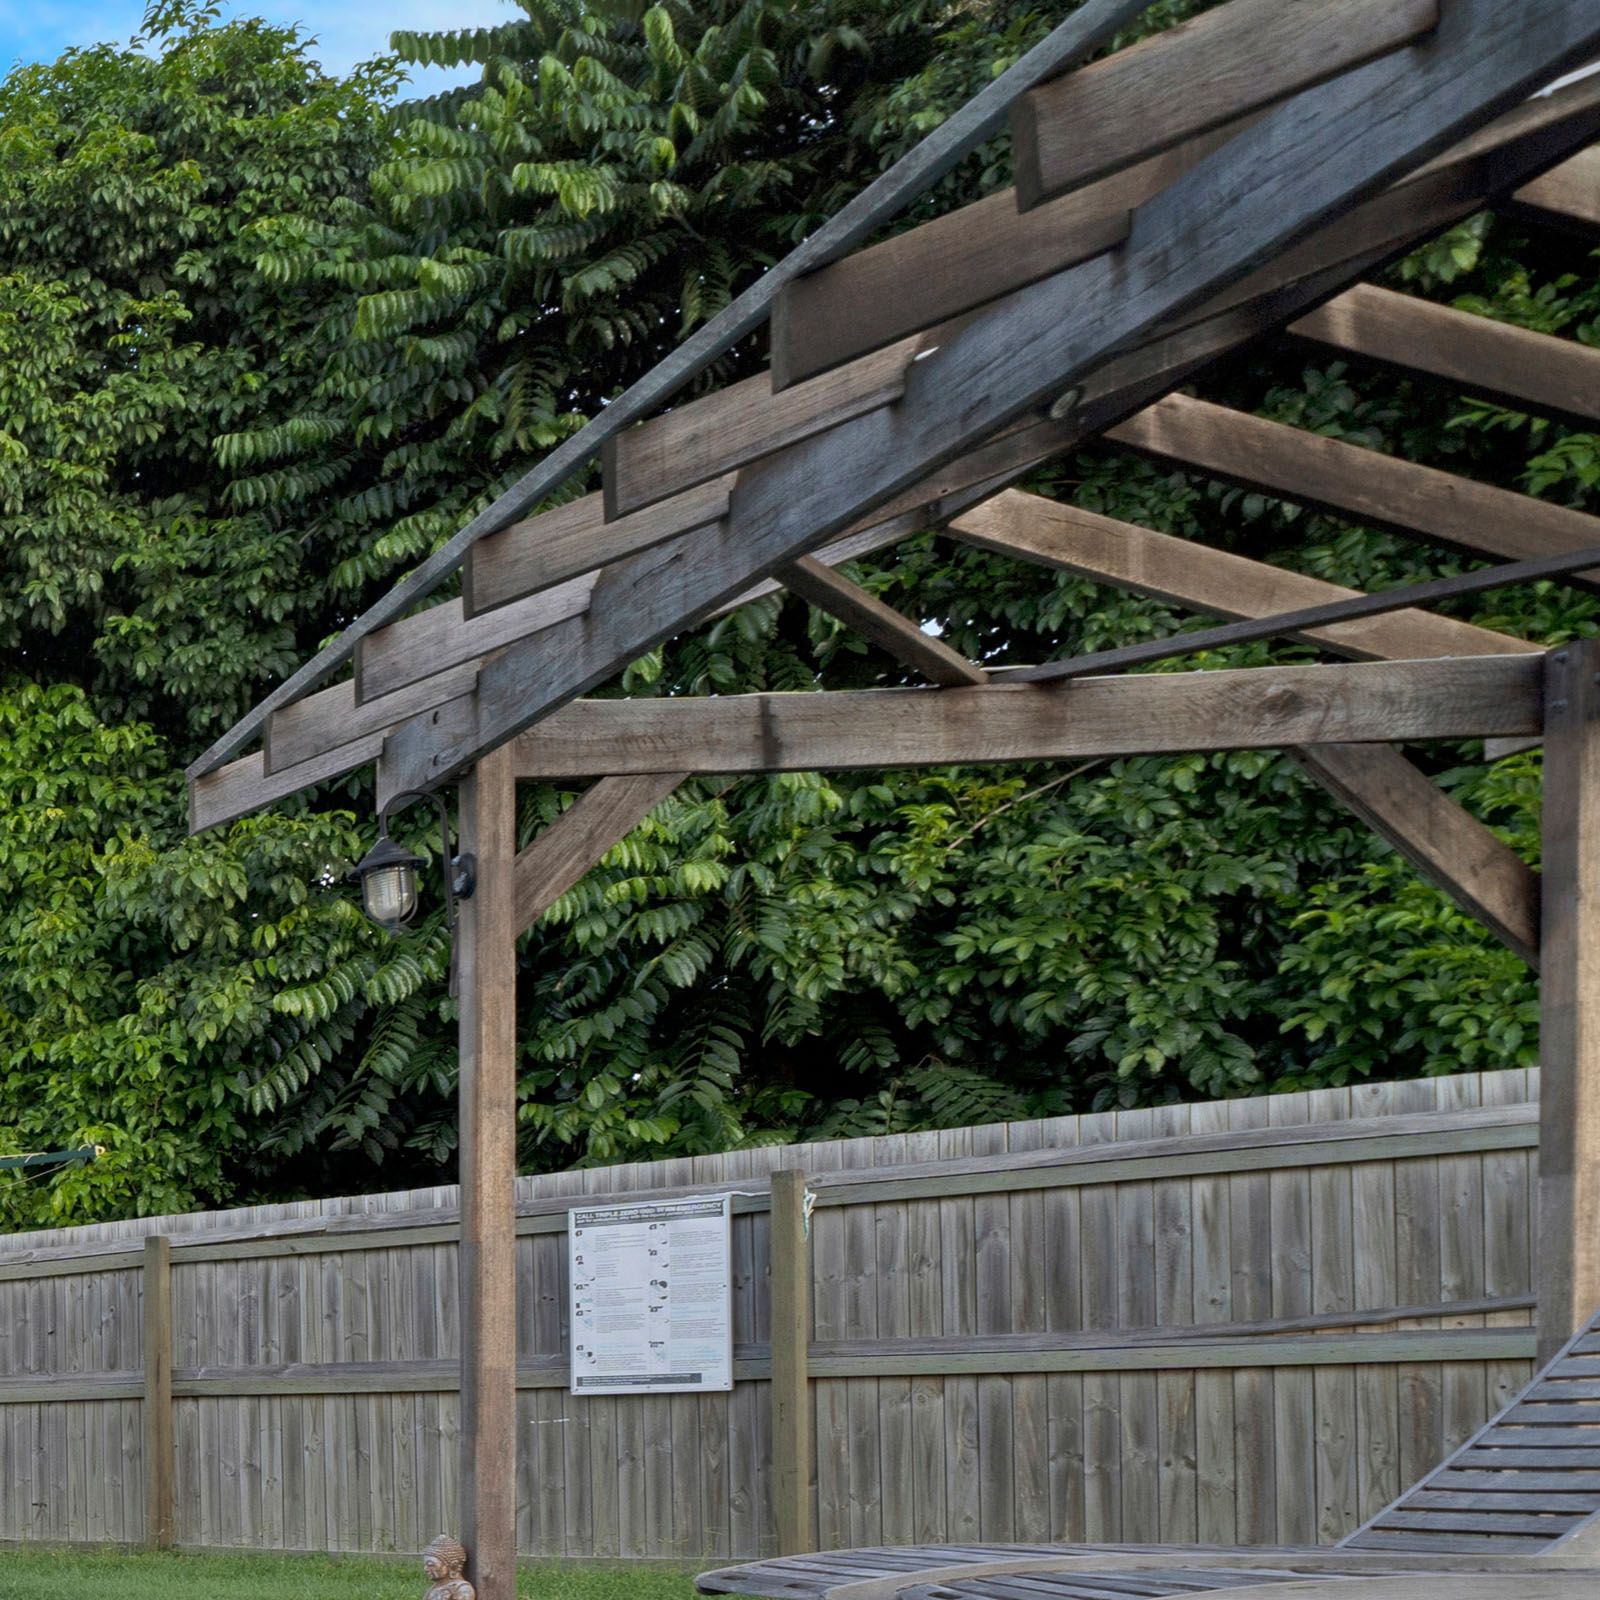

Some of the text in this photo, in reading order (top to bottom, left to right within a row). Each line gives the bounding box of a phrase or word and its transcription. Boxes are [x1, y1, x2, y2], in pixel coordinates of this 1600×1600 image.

[576, 1212, 595, 1220] CALL
[595, 1211, 618, 1219] TRIPLE
[619, 1209, 638, 1217] ZERO
[676, 1202, 722, 1212] EMERGENCY
